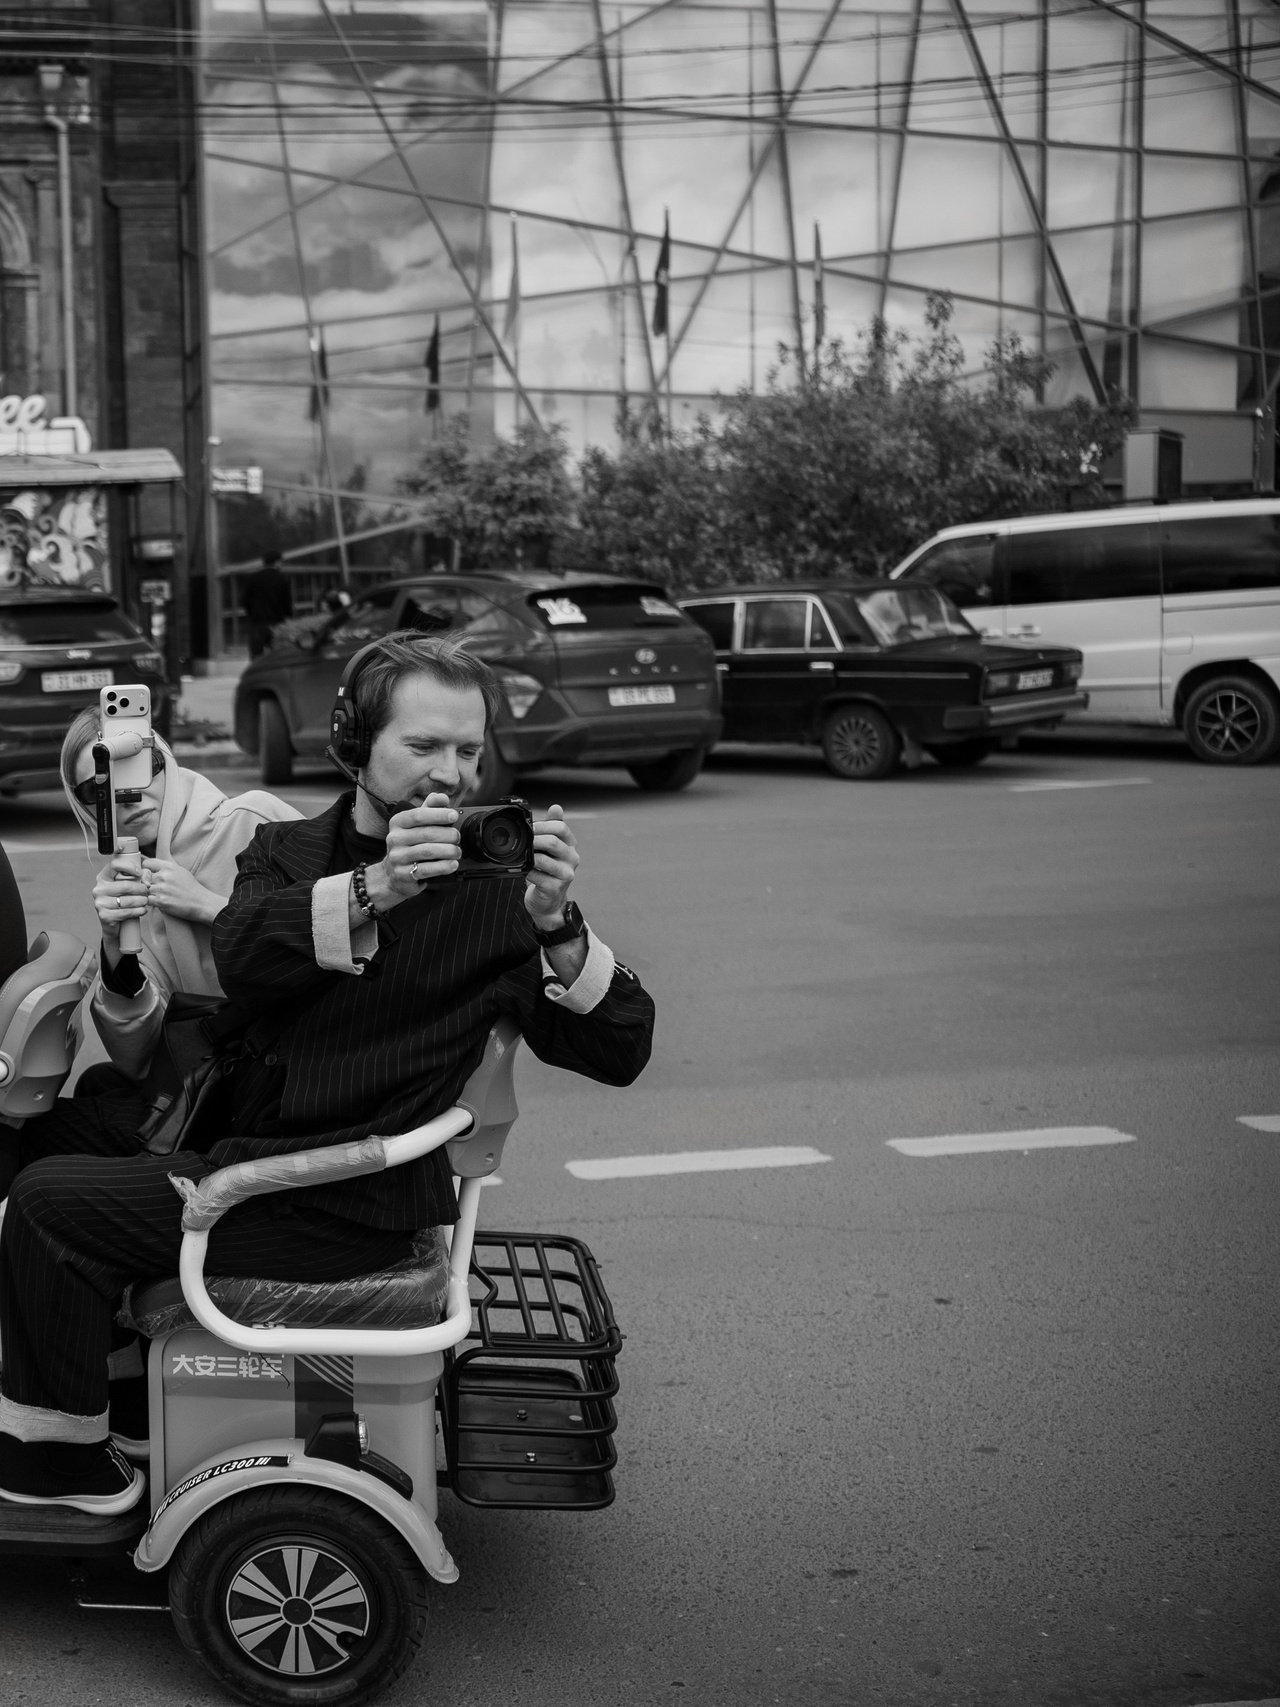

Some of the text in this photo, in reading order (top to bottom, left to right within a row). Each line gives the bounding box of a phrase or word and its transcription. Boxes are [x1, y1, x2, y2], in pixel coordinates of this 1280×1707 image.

[172, 1352, 284, 1378] 大安三轮车
[168, 1458, 255, 1503] CRUISER LC300
